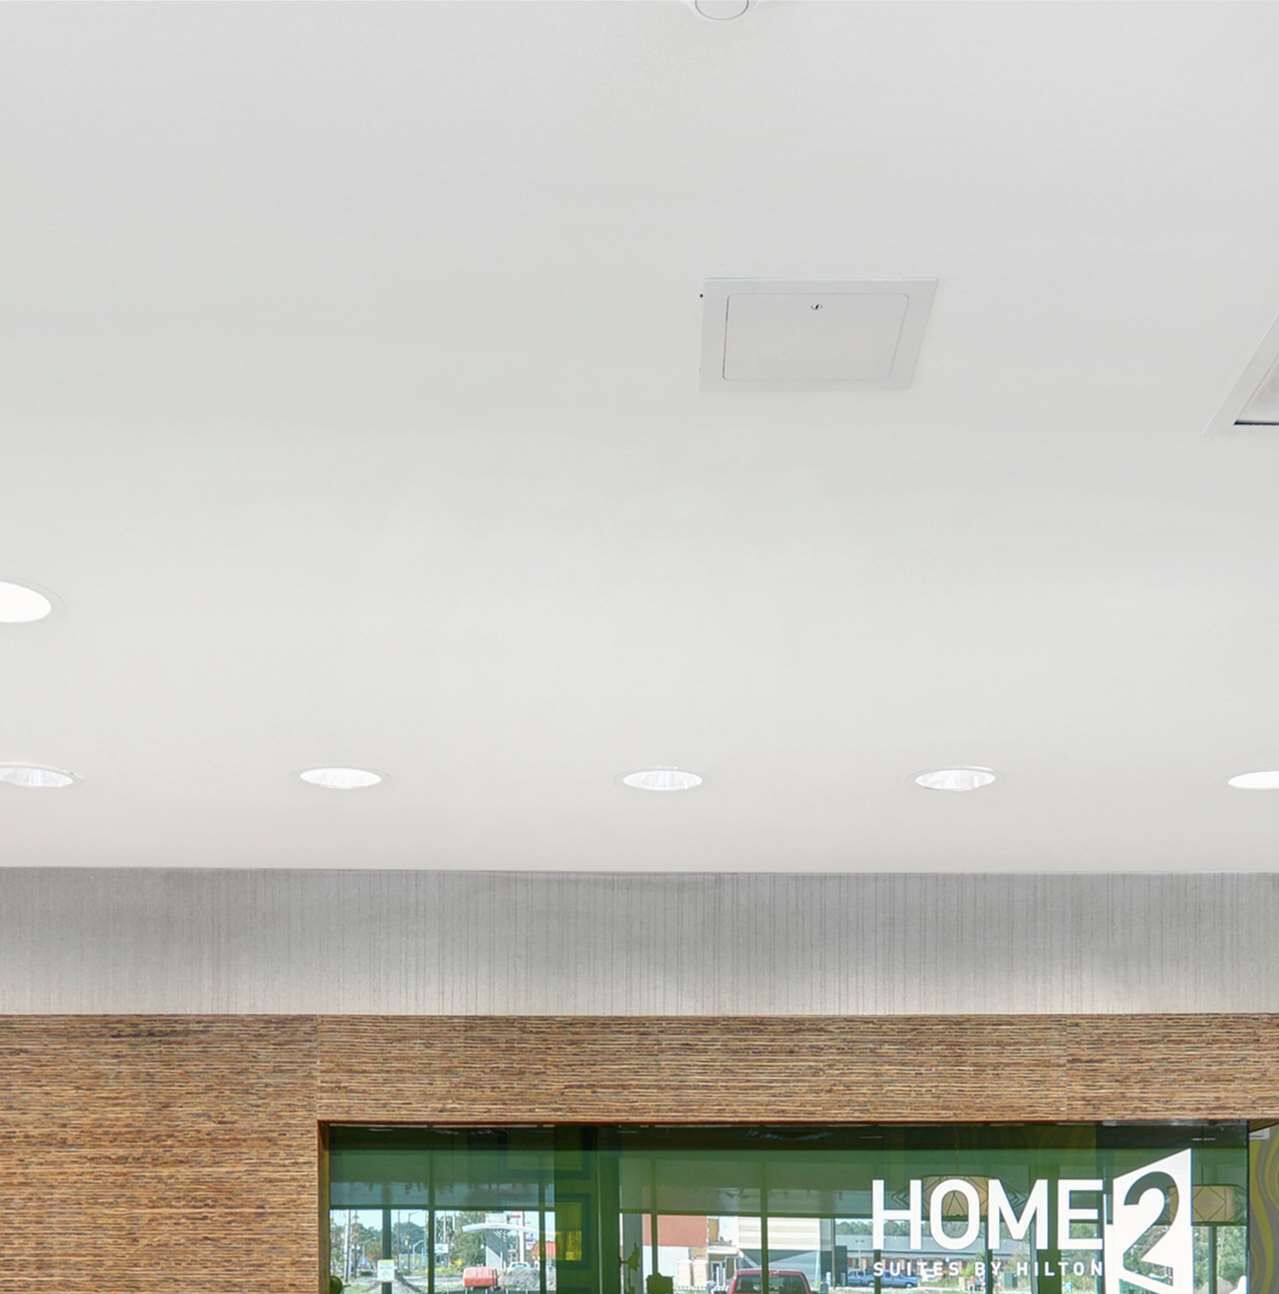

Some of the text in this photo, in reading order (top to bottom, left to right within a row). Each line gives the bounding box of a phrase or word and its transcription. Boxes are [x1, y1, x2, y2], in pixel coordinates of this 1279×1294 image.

[873, 1261, 1103, 1277] SUITES BY HILTON
